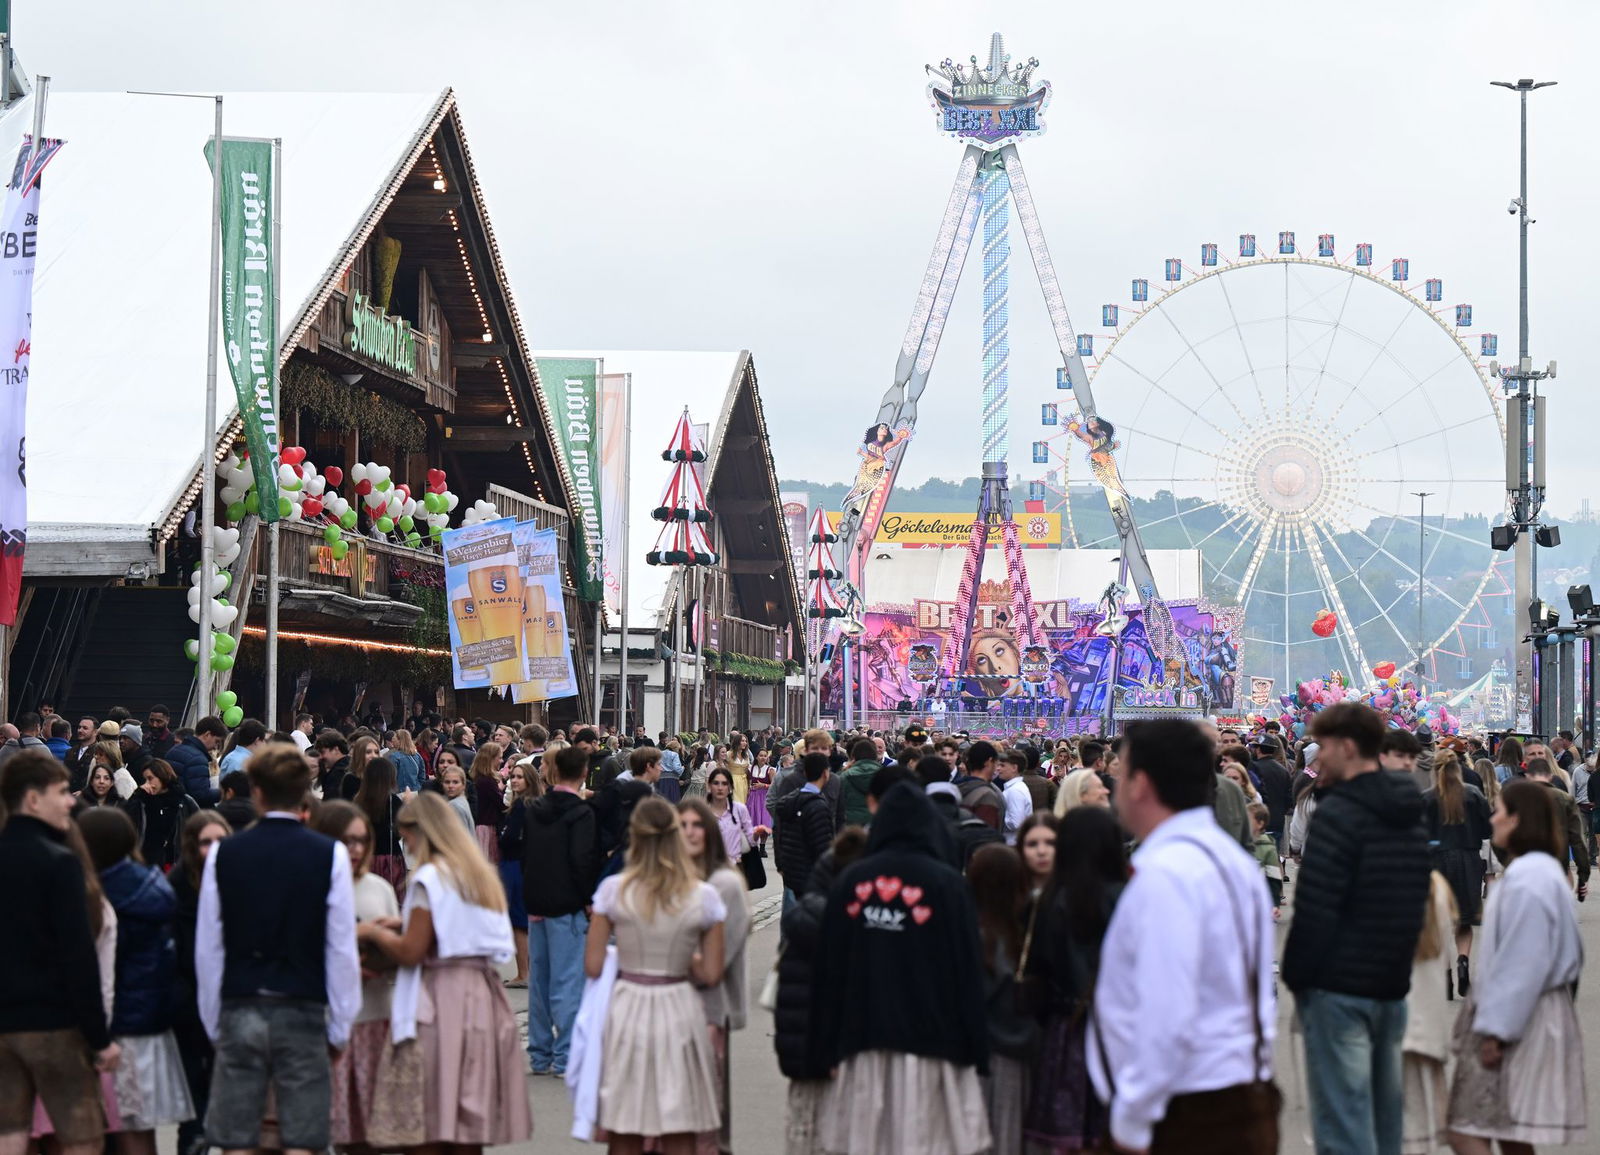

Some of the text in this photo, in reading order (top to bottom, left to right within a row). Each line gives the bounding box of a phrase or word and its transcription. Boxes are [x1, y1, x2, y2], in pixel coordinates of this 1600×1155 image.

[953, 84, 1028, 97] ZINNECKER
[943, 105, 1041, 131] BEST XXL
[451, 537, 509, 559] Weizenbier
[919, 601, 997, 628] BET
[1181, 686, 1197, 706] in
